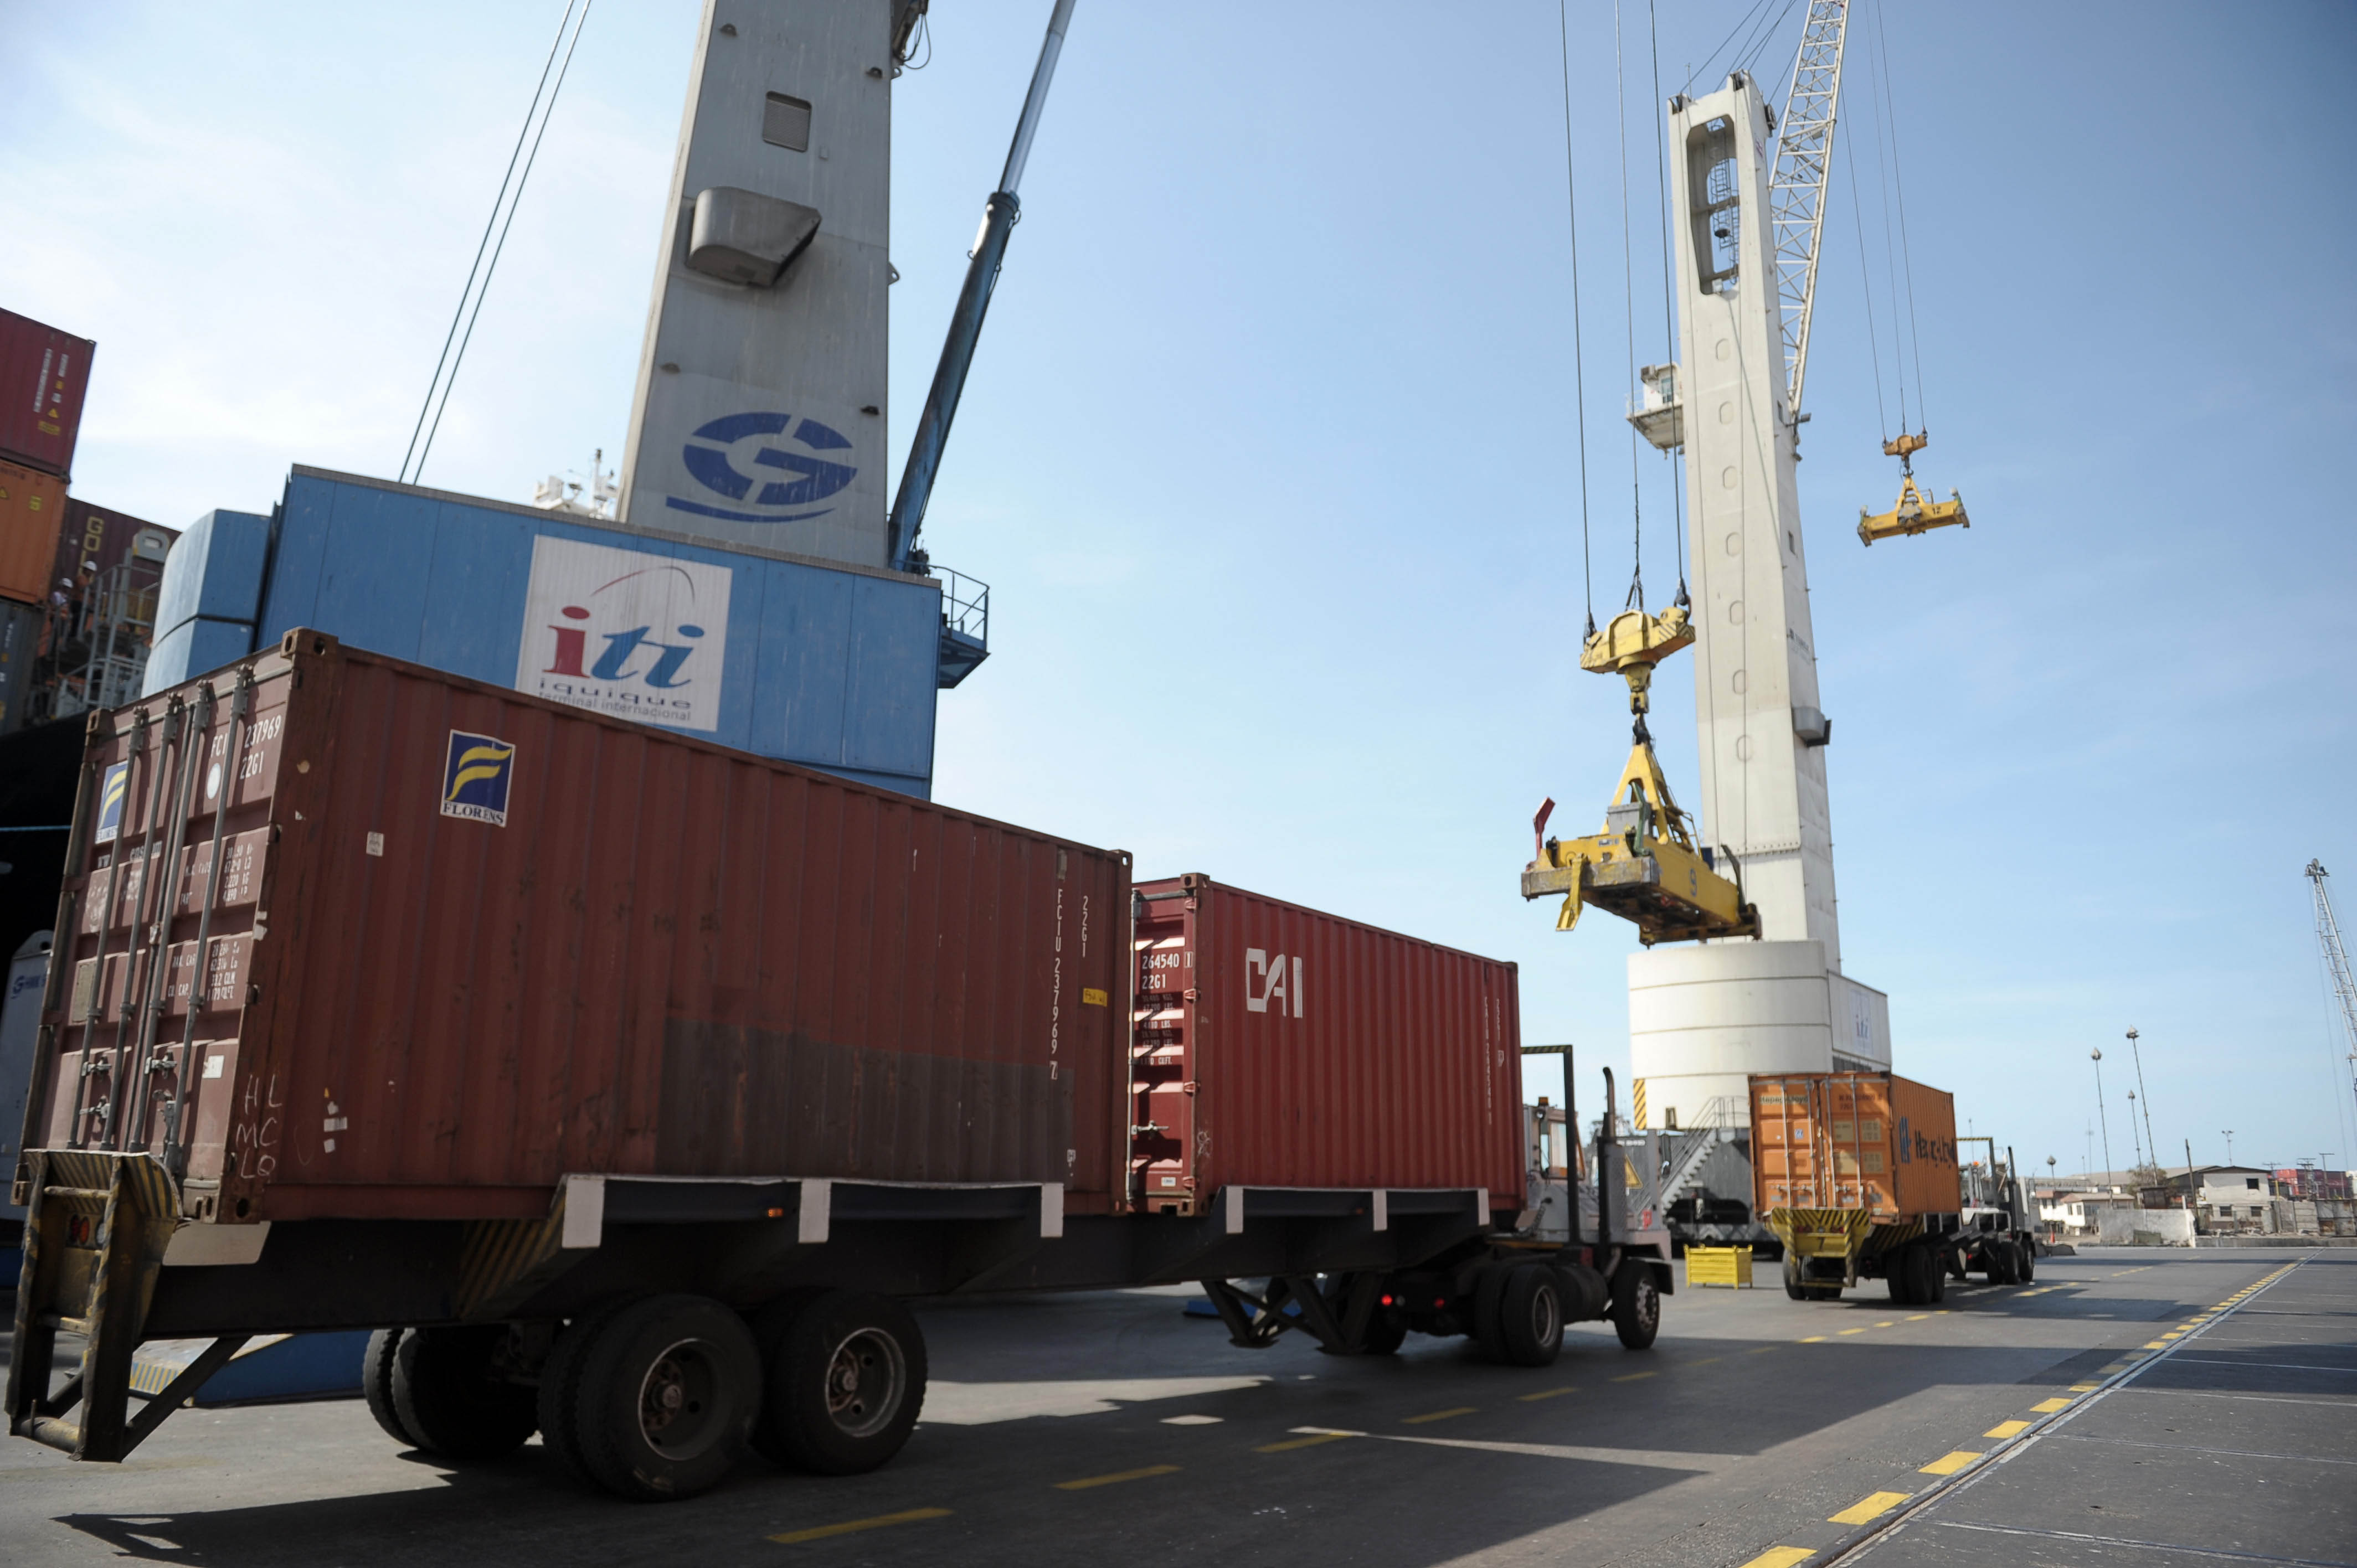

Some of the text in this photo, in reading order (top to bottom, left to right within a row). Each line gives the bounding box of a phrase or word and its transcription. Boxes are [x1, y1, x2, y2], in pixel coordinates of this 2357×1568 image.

[542, 605, 704, 688] iti
[539, 677, 691, 709] iquique
[601, 700, 691, 721] internacional
[244, 715, 281, 749] 237969
[240, 751, 264, 780] 22G1
[443, 802, 504, 824] FLORENS
[1690, 868, 1697, 897] 9
[1054, 888, 1063, 952] FCIU
[1141, 953, 1180, 969] 264540
[1141, 973, 1166, 990] 22G1
[1246, 947, 1303, 1018] CAI
[1051, 957, 1061, 1054] 237969
